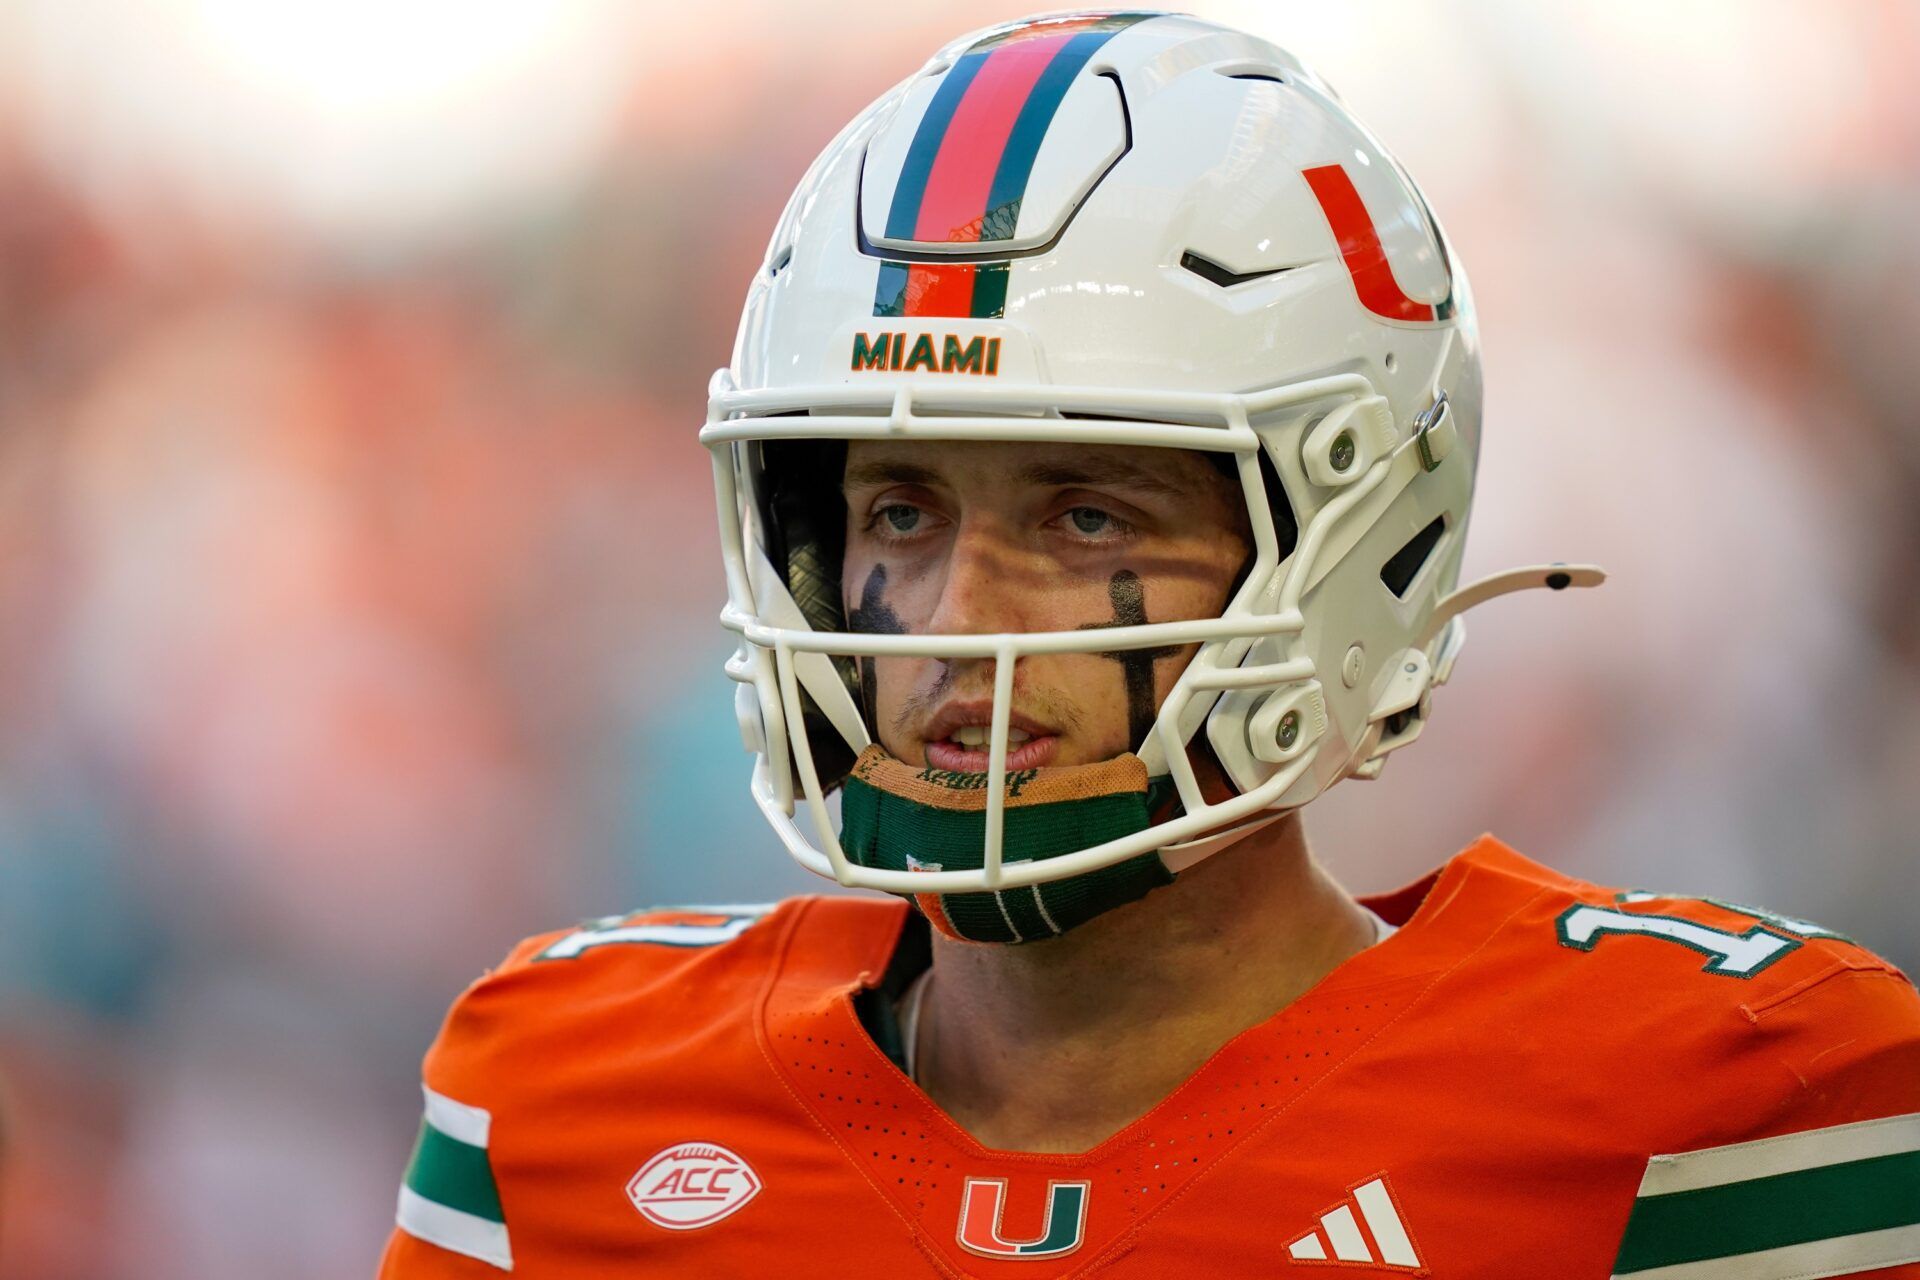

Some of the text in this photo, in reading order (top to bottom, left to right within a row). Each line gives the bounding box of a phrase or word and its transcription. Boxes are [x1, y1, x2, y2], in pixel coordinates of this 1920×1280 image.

[851, 332, 1002, 376] MIAMI
[648, 1168, 740, 1195] ACC
[955, 1175, 1092, 1261] U
